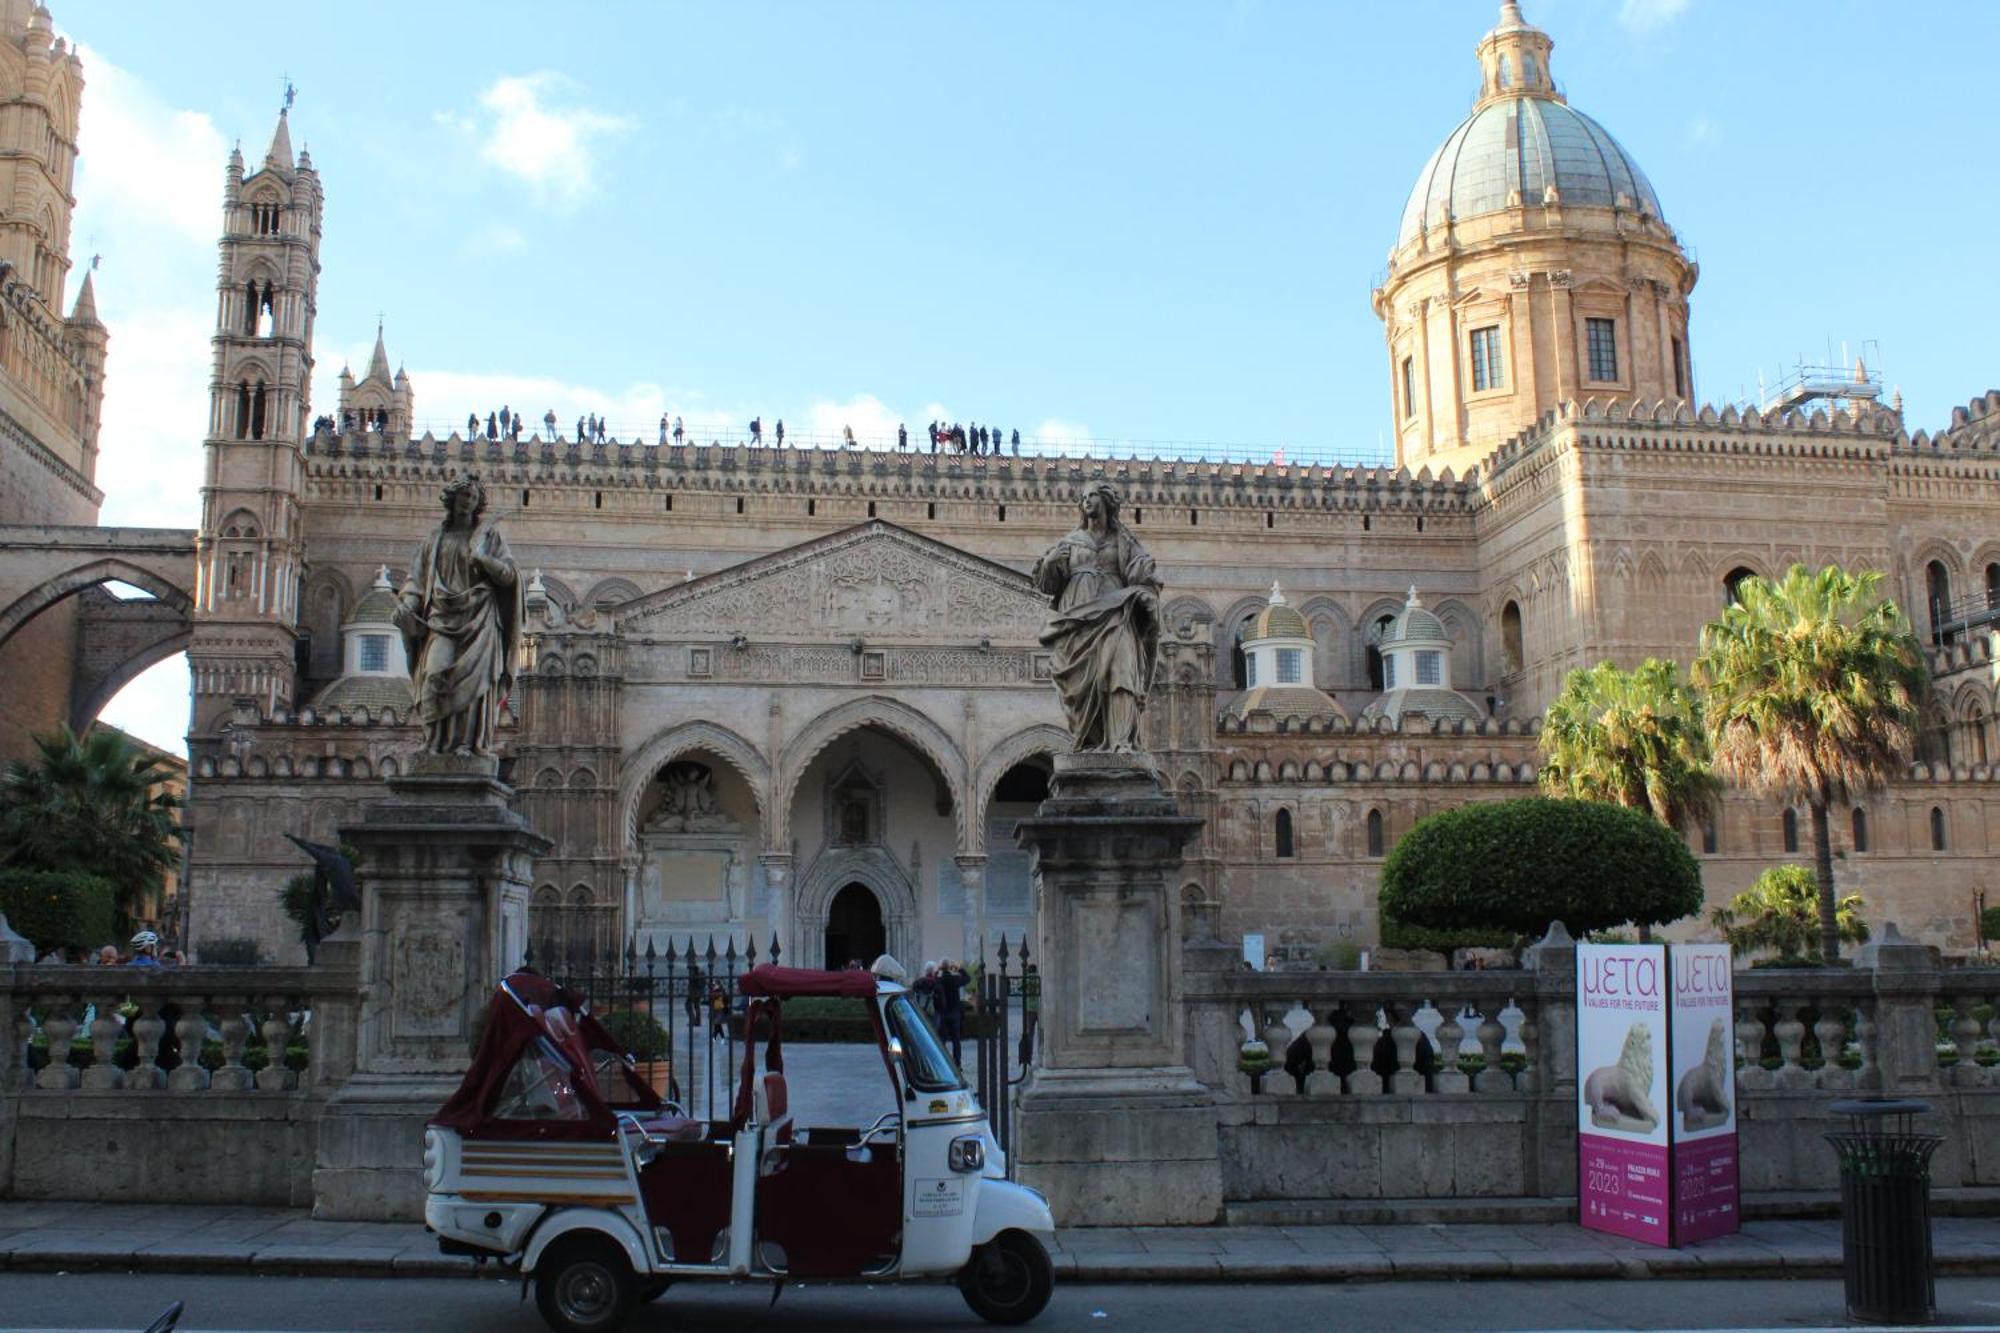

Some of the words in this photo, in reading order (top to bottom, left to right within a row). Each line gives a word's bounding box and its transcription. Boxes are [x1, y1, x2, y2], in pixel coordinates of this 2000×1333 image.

[1610, 999, 1621, 1009] FOR
[1622, 1000, 1633, 1010] THE
[1634, 1000, 1658, 1011] FUTURE
[1588, 1170, 1619, 1195] 2023
